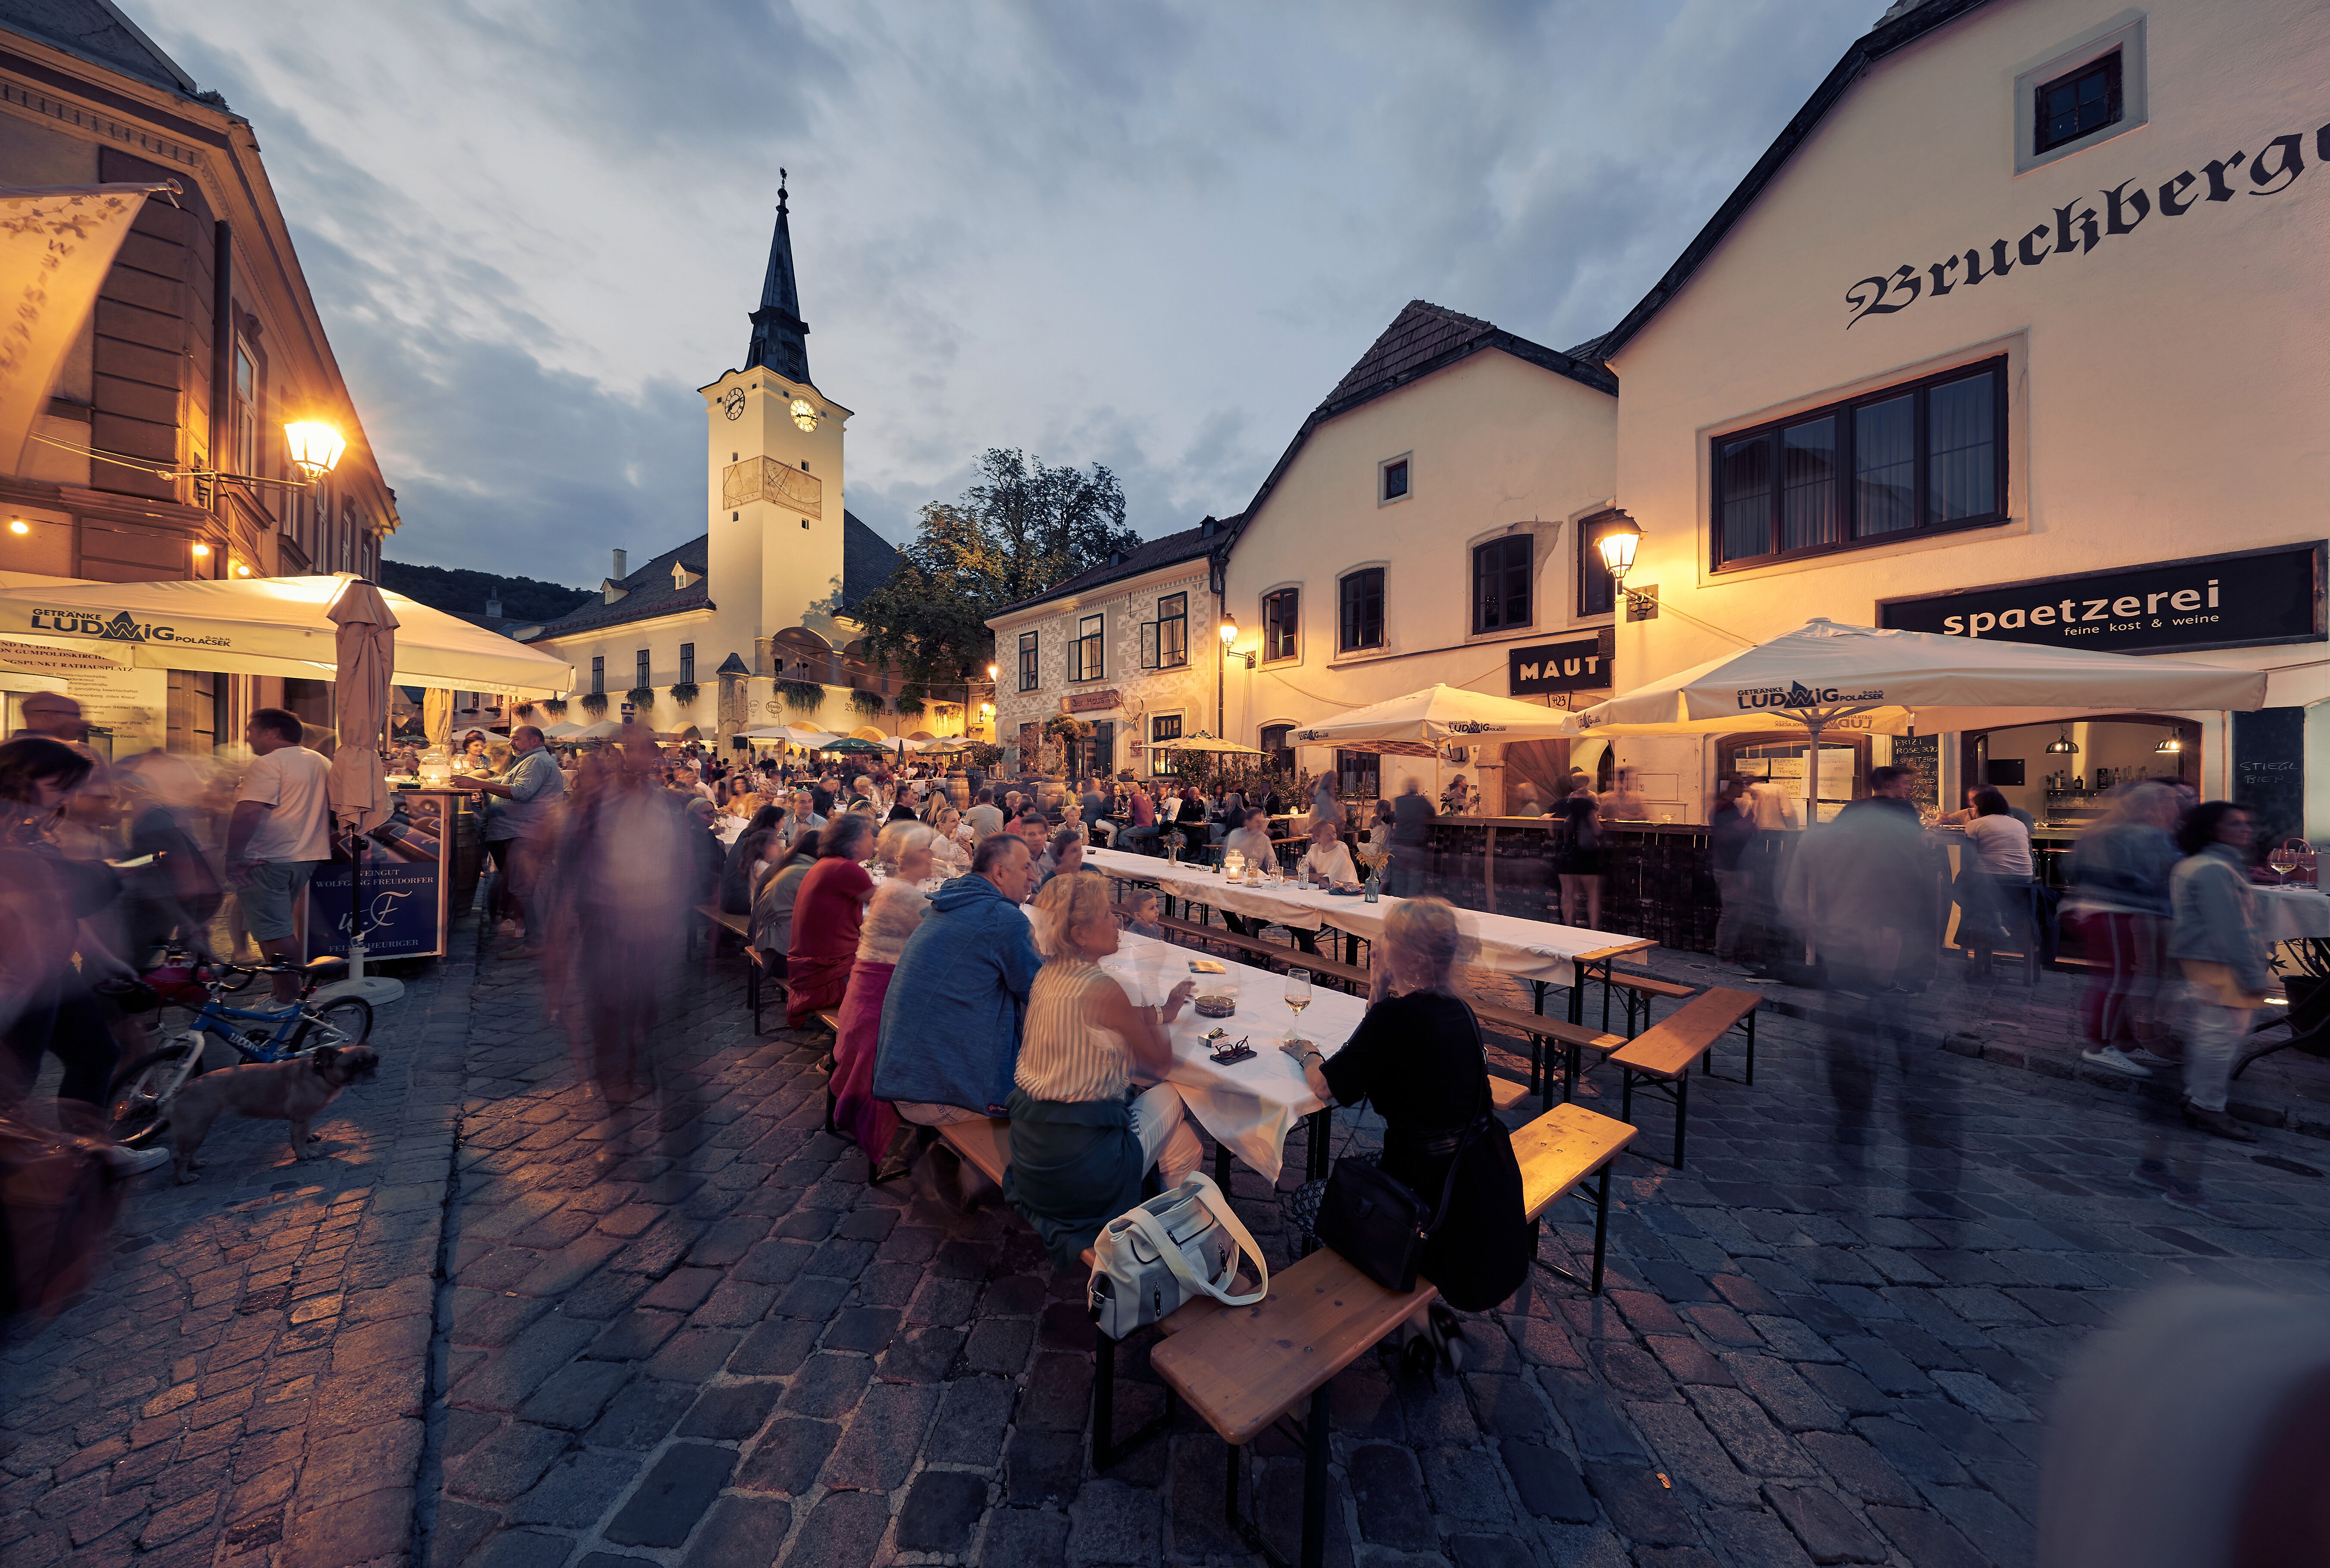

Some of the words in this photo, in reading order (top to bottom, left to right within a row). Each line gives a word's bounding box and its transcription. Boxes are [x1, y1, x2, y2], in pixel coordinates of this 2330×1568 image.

[33, 609, 102, 620] GETRÄNKE
[1944, 580, 2220, 640] spaetzerei
[2065, 625, 2100, 637] feine
[2109, 620, 2141, 632] kost
[2151, 618, 2162, 629] &
[2173, 614, 2220, 626] weine
[175, 636, 231, 647] POLACSEK
[15, 650, 110, 660] GUMPOLDSKIRCH
[62, 663, 134, 672] RATHAUSPLATZ
[1520, 656, 1598, 681] MAUT
[1738, 687, 1784, 696] GETRÄNKE
[1840, 693, 1884, 701] POLACSEK
[2239, 761, 2299, 770] STIEGL
[2245, 775, 2292, 784] BIER
[316, 879, 370, 887] WOLFGG
[373, 877, 434, 885] FREUDORFER
[228, 1032, 259, 1052] woom
